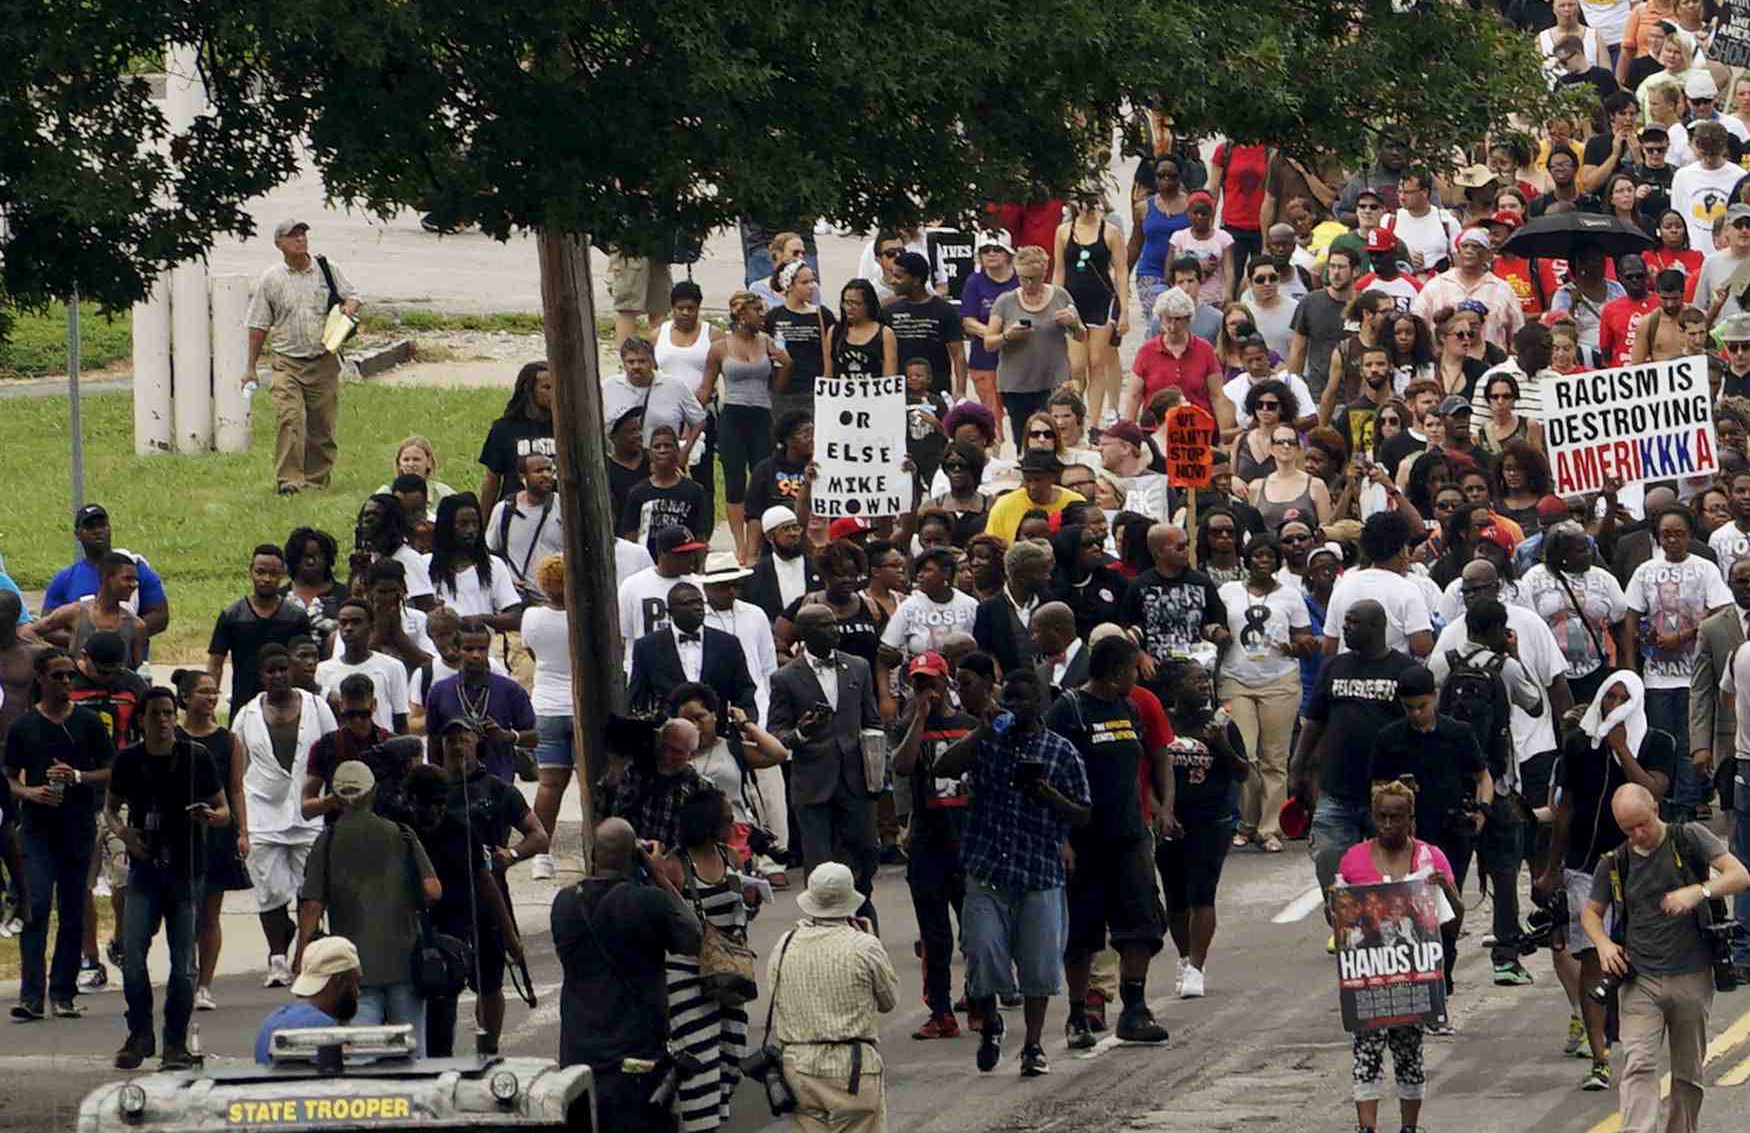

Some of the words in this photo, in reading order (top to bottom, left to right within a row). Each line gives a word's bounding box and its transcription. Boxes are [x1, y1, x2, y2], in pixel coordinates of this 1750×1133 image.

[943, 245, 973, 259] IVES
[816, 377, 904, 398] JUSTICE
[1556, 372, 1659, 409] RACISM
[1669, 363, 1694, 393] IS
[840, 410, 871, 429] OR
[1176, 412, 1196, 428] WE
[1549, 395, 1708, 448] DESTROYING
[827, 442, 891, 463] ELSE
[1170, 446, 1205, 461] STOP
[1557, 428, 1714, 494] AMERIKKKA
[1175, 463, 1207, 479] NOW
[828, 475, 886, 494] MIKE
[814, 495, 901, 516] BROWN
[1340, 943, 1411, 981] HANDS
[1412, 941, 1444, 974] UP
[228, 1100, 298, 1124] STATE
[304, 1097, 411, 1121] TROOPER
